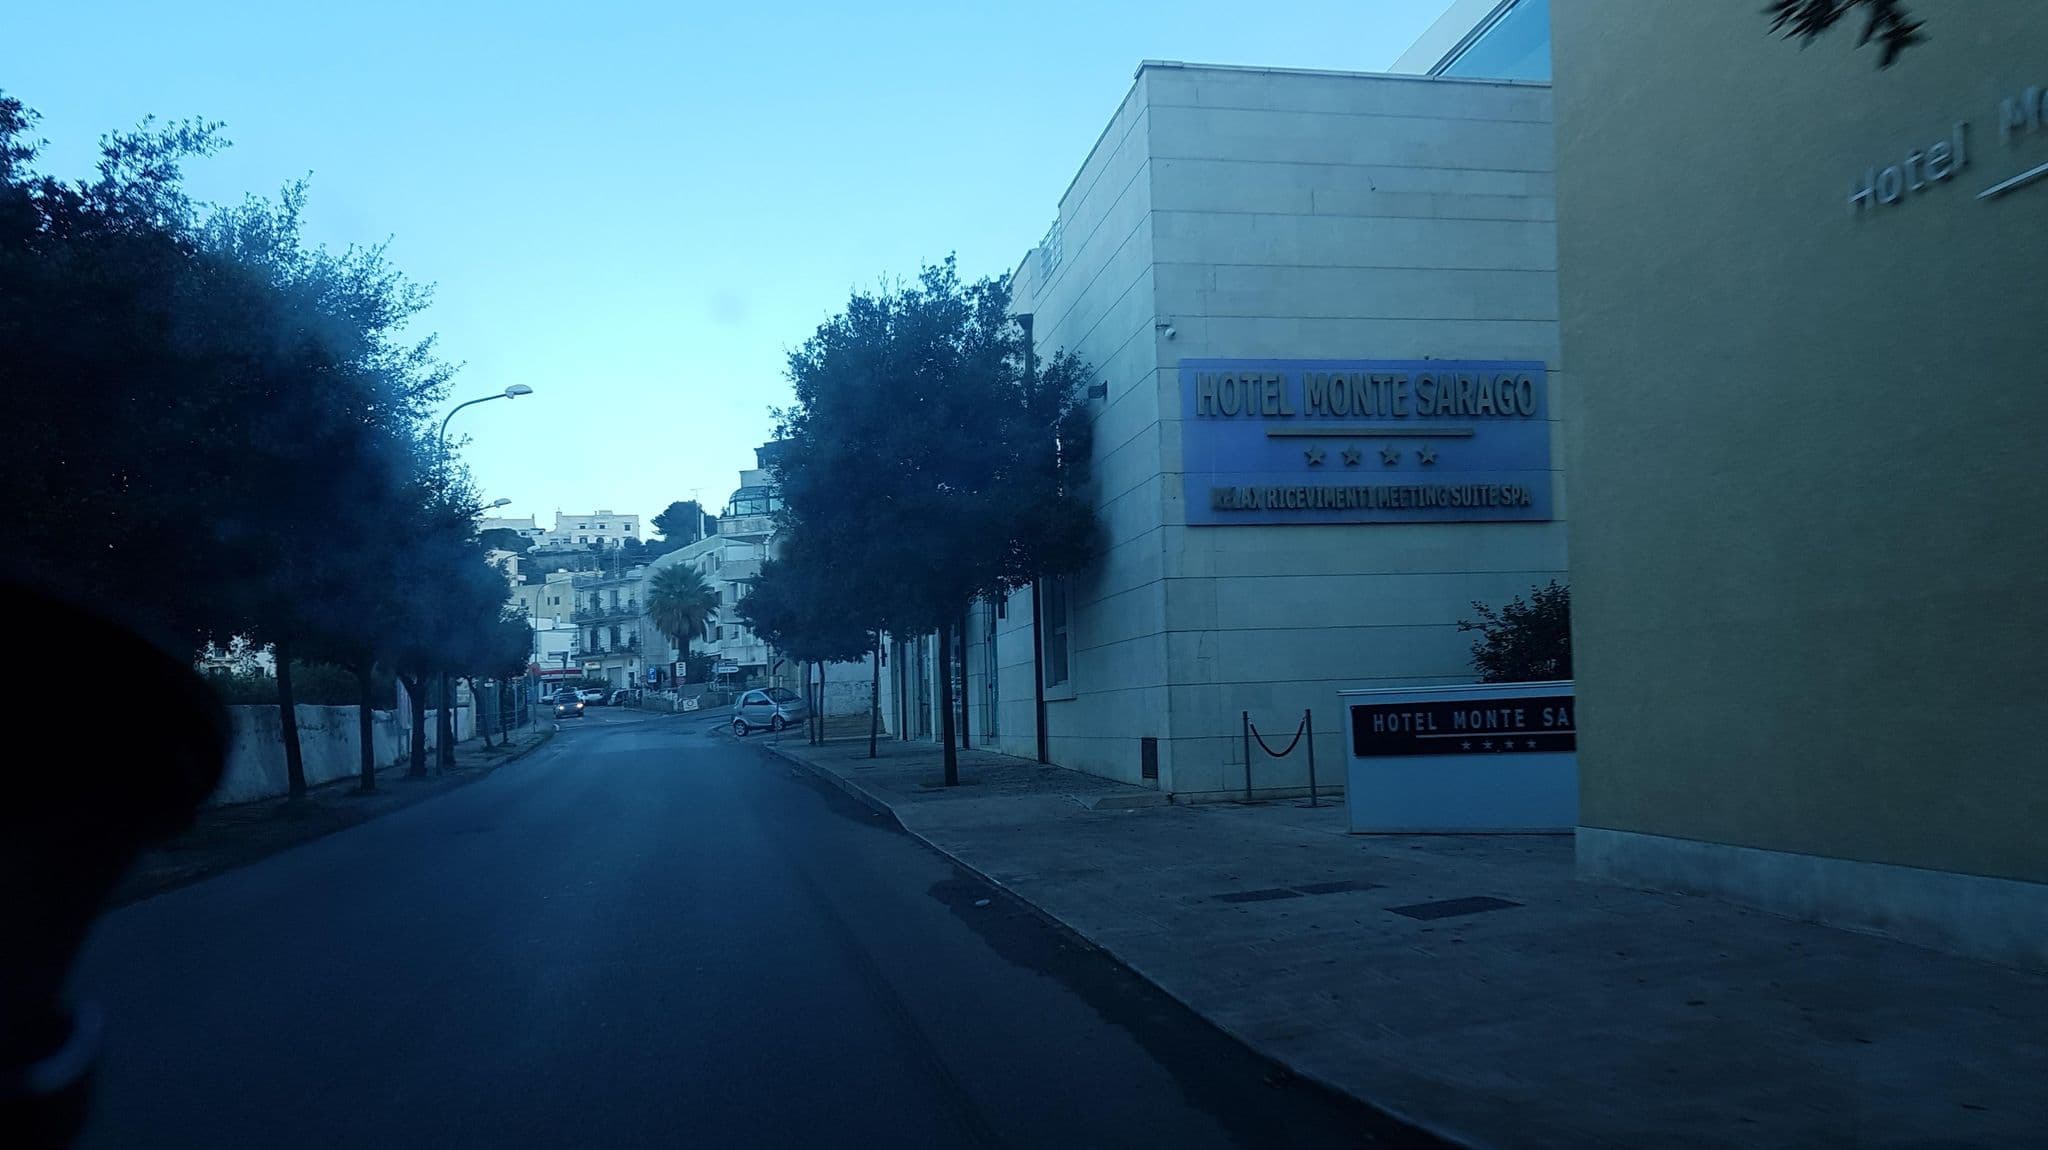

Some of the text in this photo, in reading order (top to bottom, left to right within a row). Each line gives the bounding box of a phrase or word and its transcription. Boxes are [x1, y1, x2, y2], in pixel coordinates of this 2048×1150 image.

[1849, 119, 1968, 212] Hotel
[1196, 372, 1537, 417] HOTEL MONTE SARAGO
[1265, 487, 1375, 511] RICEVIMENTI
[1376, 486, 1449, 509] MEETING
[1450, 486, 1497, 507] SUITE
[1500, 486, 1532, 505] SPA
[1372, 712, 1438, 733] HOTEL
[1453, 708, 1526, 729] MONTE
